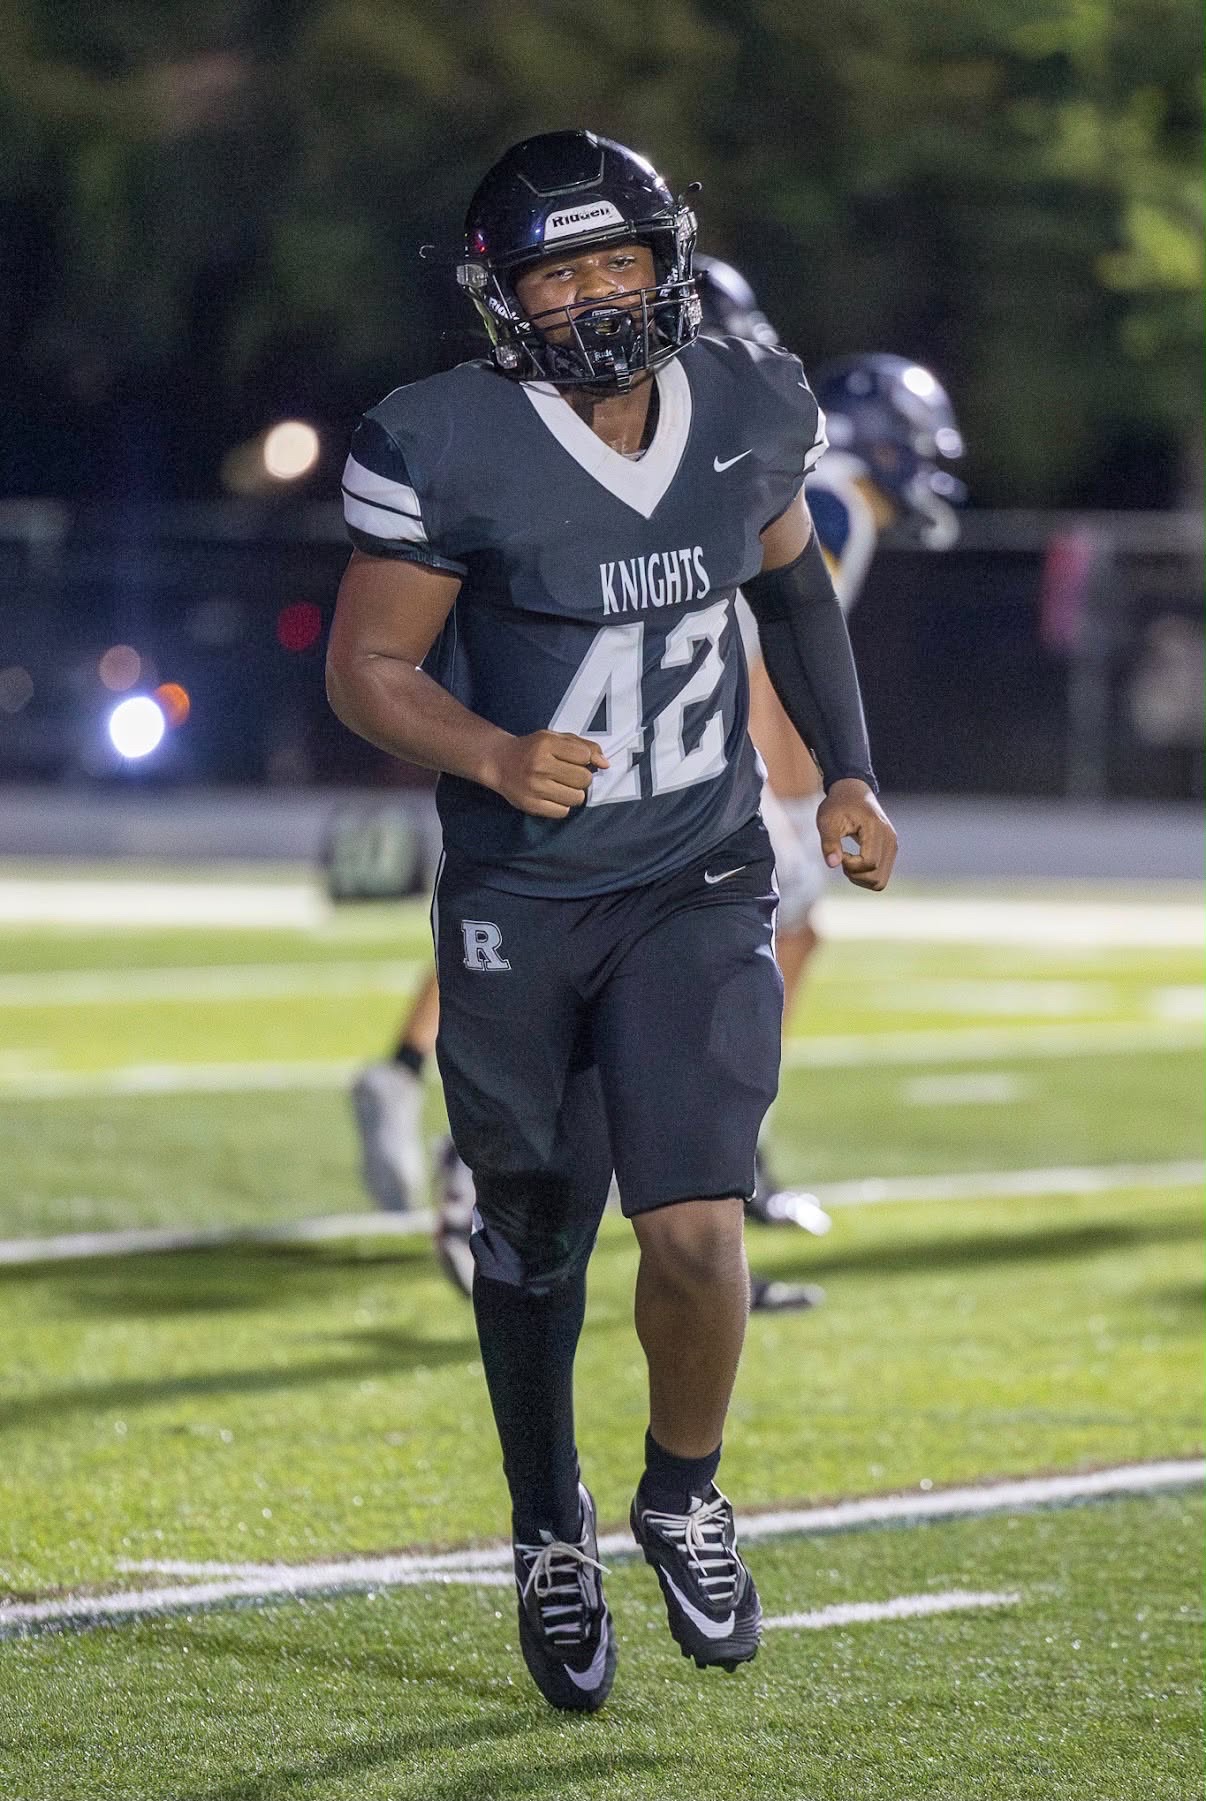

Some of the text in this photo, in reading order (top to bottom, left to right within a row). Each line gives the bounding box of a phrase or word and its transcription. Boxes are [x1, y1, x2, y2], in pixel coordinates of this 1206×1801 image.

[600, 546, 710, 615] KNIGHTS
[548, 599, 729, 807] 42
[461, 919, 512, 972] R
